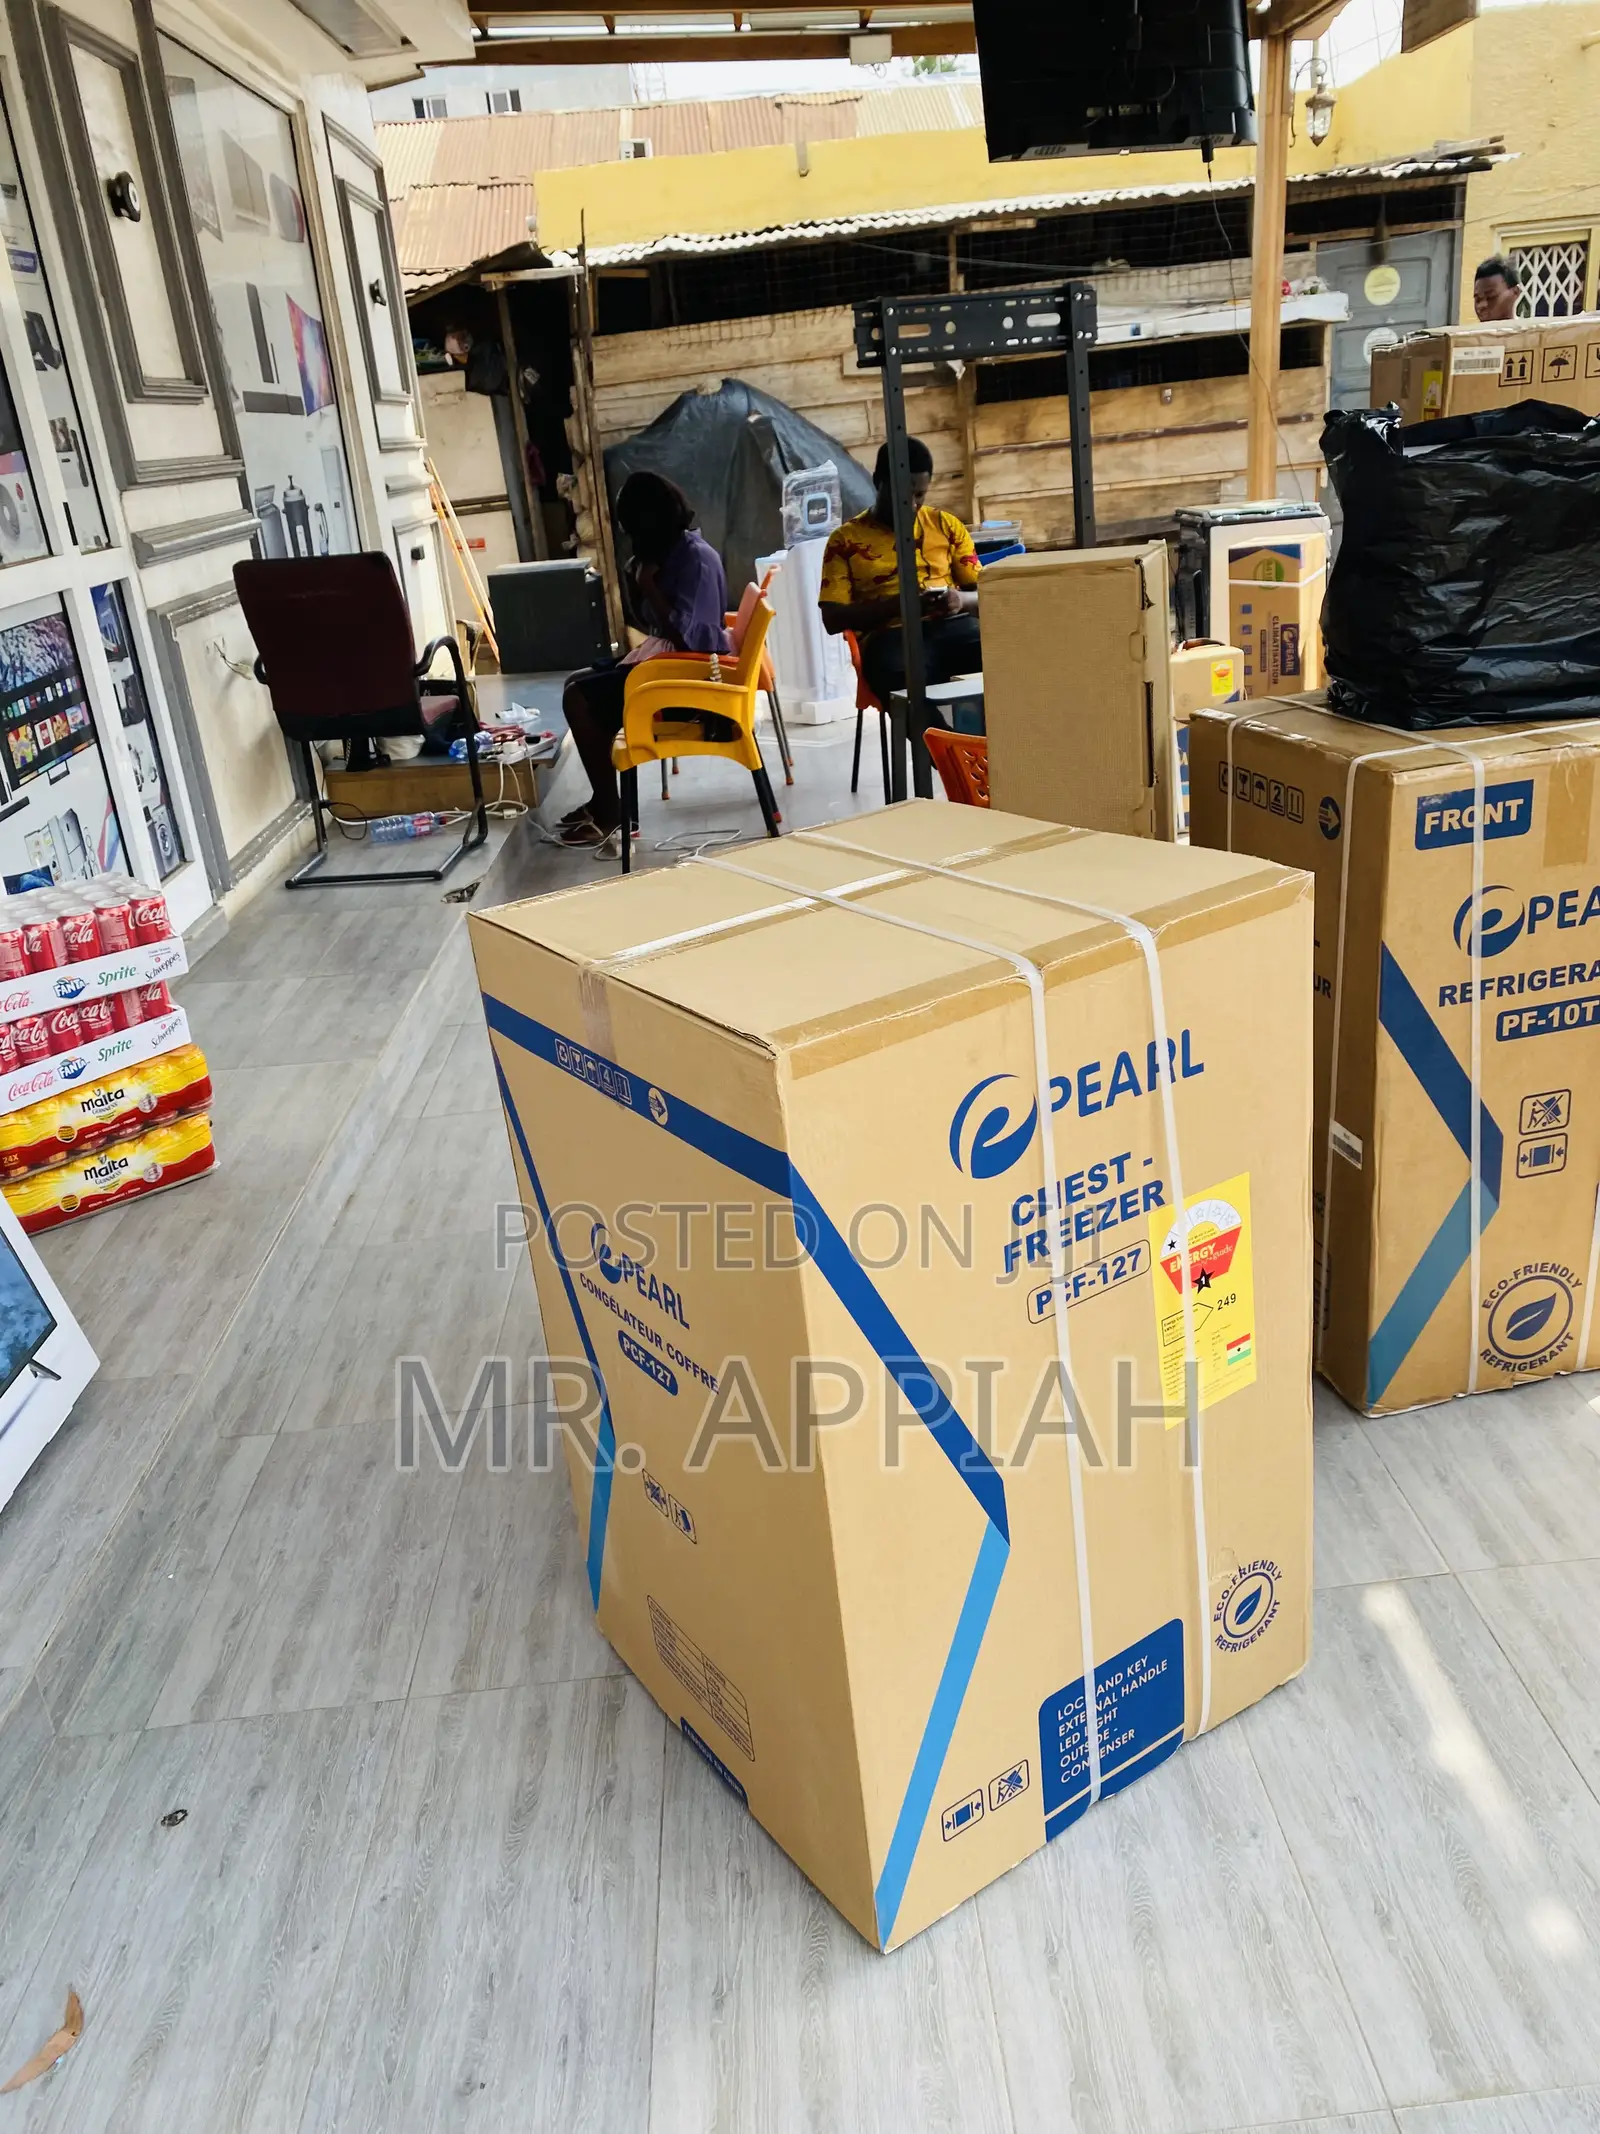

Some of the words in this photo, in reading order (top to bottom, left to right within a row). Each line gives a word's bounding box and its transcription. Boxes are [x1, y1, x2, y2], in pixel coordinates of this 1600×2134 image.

[1424, 798, 1524, 835] FRONT
[54, 979, 86, 997] FANTA
[97, 966, 137, 986] Sprite
[144, 951, 181, 982] Schweppes
[58, 1058, 87, 1078] FANTA
[98, 1039, 133, 1061] Sprite
[1049, 1028, 1204, 1118] PEARL
[80, 1088, 125, 1113] Malta
[84, 1158, 129, 1181] Malta
[1012, 1151, 1131, 1227] CHEST
[1004, 1179, 1165, 1274] FREEZER
[621, 1252, 691, 1331] PEARL
[1036, 1247, 1142, 1316] PF-127
[1217, 1293, 1237, 1311] 249
[1481, 1262, 1583, 1311] ECO-FRIENDLY
[622, 1336, 672, 1388] PCF-127
[666, 1342, 720, 1395] COFFRE
[1480, 1331, 1575, 1373] REFRIGERANT
[1213, 1559, 1283, 1623] ECO-FRIENDLY
[1214, 1599, 1281, 1653] REFRIGERANT
[1058, 1696, 1084, 1720] LOC
[1096, 1672, 1123, 1697] AND
[1127, 1655, 1149, 1677] KEY
[1059, 1692, 1118, 1737] EXTENAL
[1121, 1659, 1168, 1697] HANDLE
[1059, 1732, 1081, 1753] LED
[1084, 1707, 1118, 1737] LGHT
[1060, 1728, 1110, 1768] OUTSDE
[1061, 1729, 1135, 1783] CONENSER
